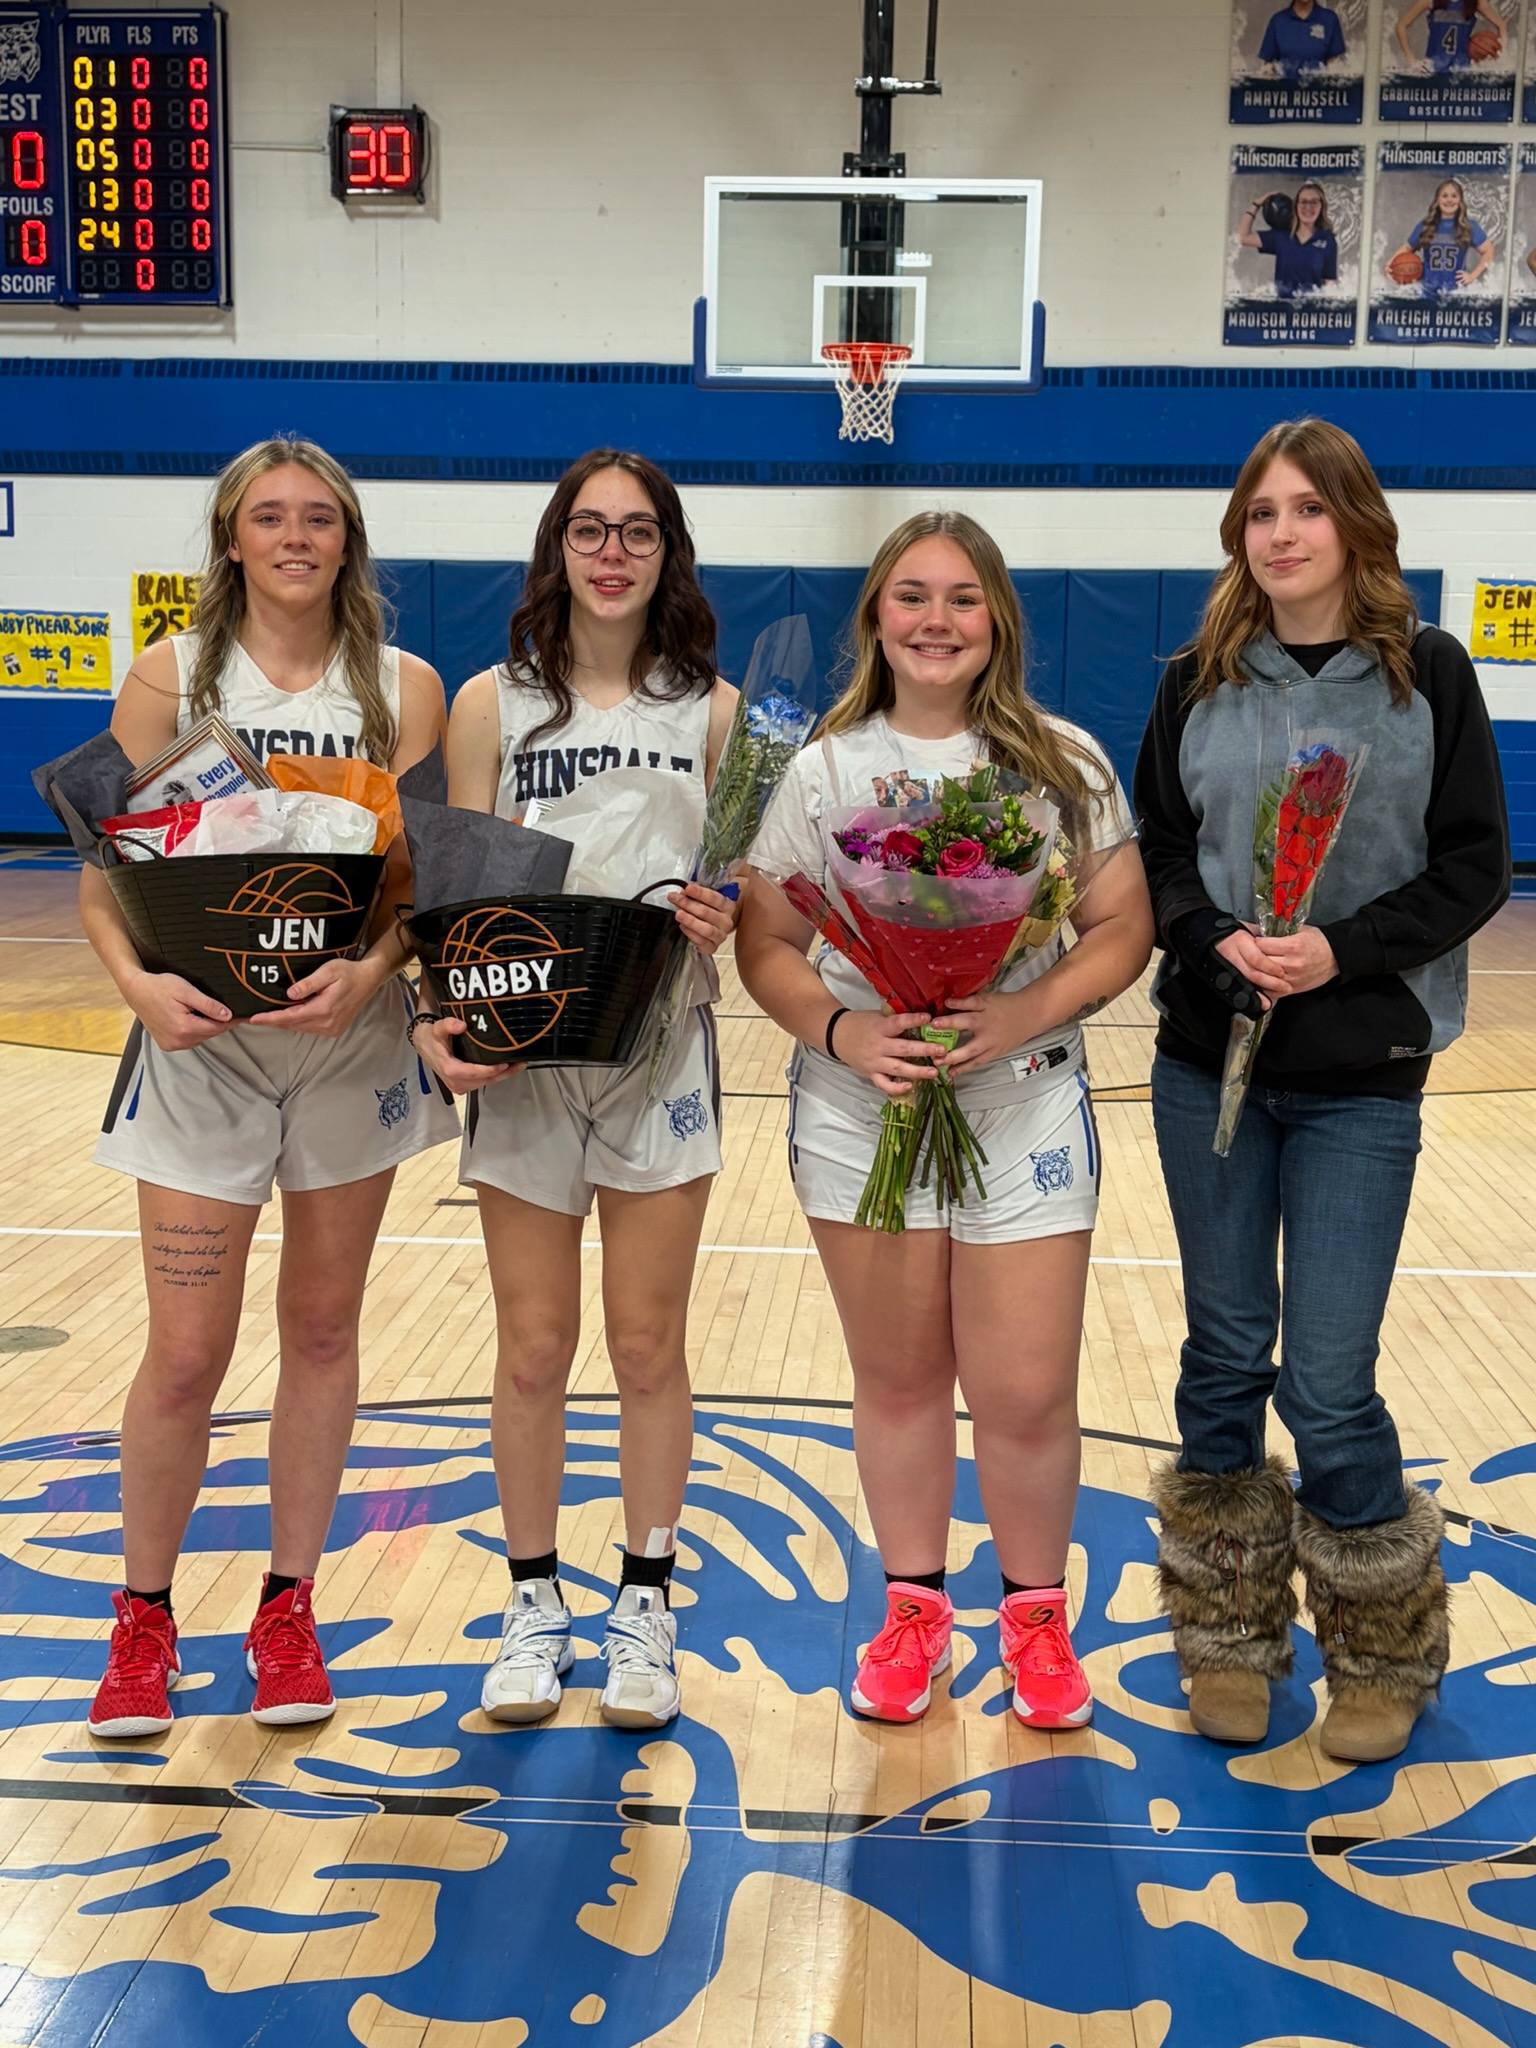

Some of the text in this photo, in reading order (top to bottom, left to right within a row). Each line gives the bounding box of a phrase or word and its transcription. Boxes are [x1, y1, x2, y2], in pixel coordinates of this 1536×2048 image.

[76, 25, 198, 45] PLYR FLS PTS
[1441, 25, 1457, 55] 4
[131, 57, 150, 90] 0
[189, 57, 208, 90] 0
[1244, 91, 1349, 106] AMAYA RUSSELL
[1382, 88, 1439, 101] GABRIELLA
[75, 97, 209, 131] 03 0 0
[1269, 108, 1323, 119] BOWLING
[1409, 106, 1482, 116] BASKETBALL
[13, 131, 44, 189] 0
[76, 138, 209, 171] 05 0 0
[349, 126, 411, 183] 30
[1239, 152, 1360, 168] HINSDALE BOBCATS
[1385, 150, 1506, 165] HINSDALE BOBCATS
[0, 197, 54, 216] FOULS
[134, 178, 153, 211] 0
[191, 178, 210, 211] 0
[21, 219, 47, 265] 0
[78, 218, 211, 251] 24 0 0
[1430, 246, 1459, 271] 25
[136, 258, 155, 291] 0
[1228, 312, 1352, 328] MADISON RONDEAU
[1376, 309, 1493, 327] KALEIGH BUCKLES
[1397, 327, 1470, 338] BASKETBALL
[1263, 329, 1316, 340] BOWLING
[137, 574, 203, 607] KALE
[196, 757, 236, 790] Every
[258, 918, 325, 950] JEN
[448, 959, 554, 1000] GABBY
